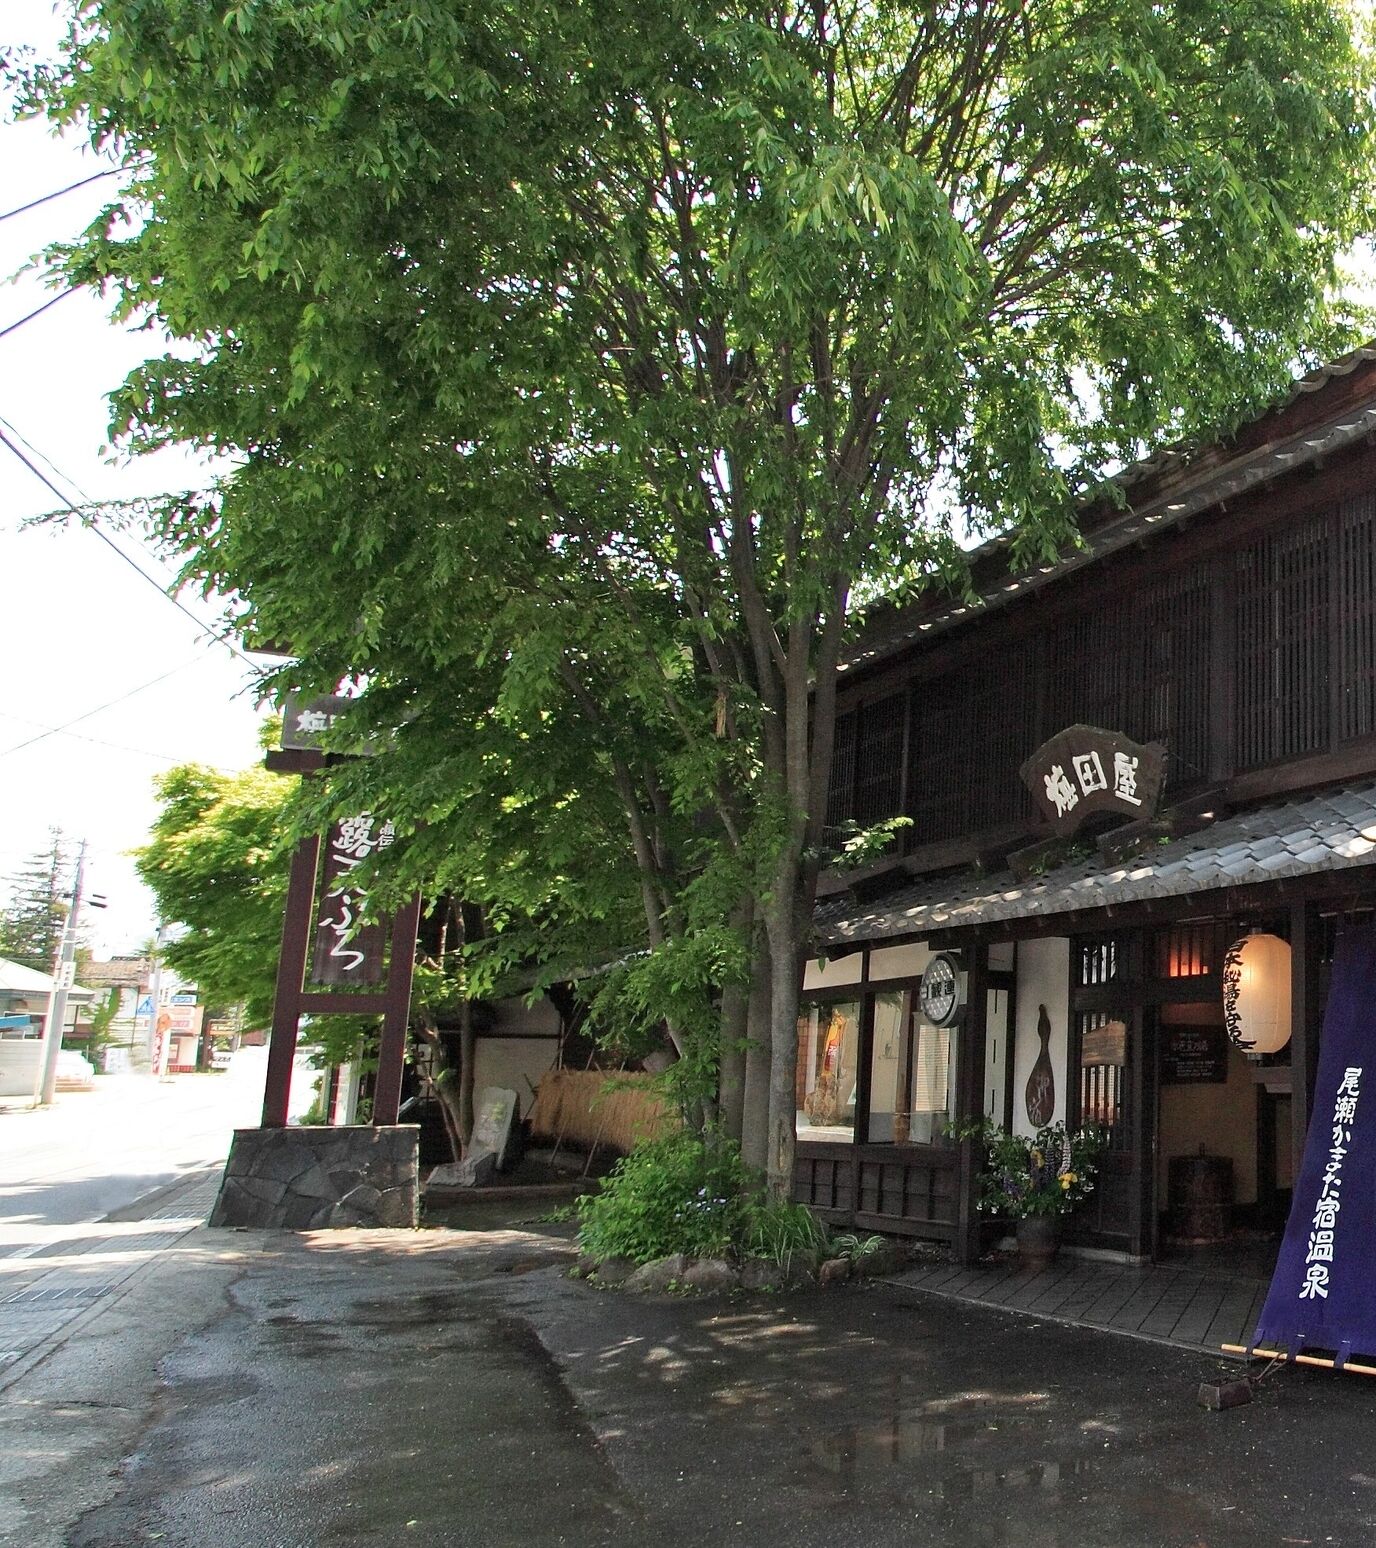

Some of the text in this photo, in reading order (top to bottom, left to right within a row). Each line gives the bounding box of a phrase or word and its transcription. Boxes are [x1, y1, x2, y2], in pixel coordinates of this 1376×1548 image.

[1043, 750, 1142, 818] 梅田屋
[1298, 1067, 1363, 1300] 尾瀬かまた宿温泉
